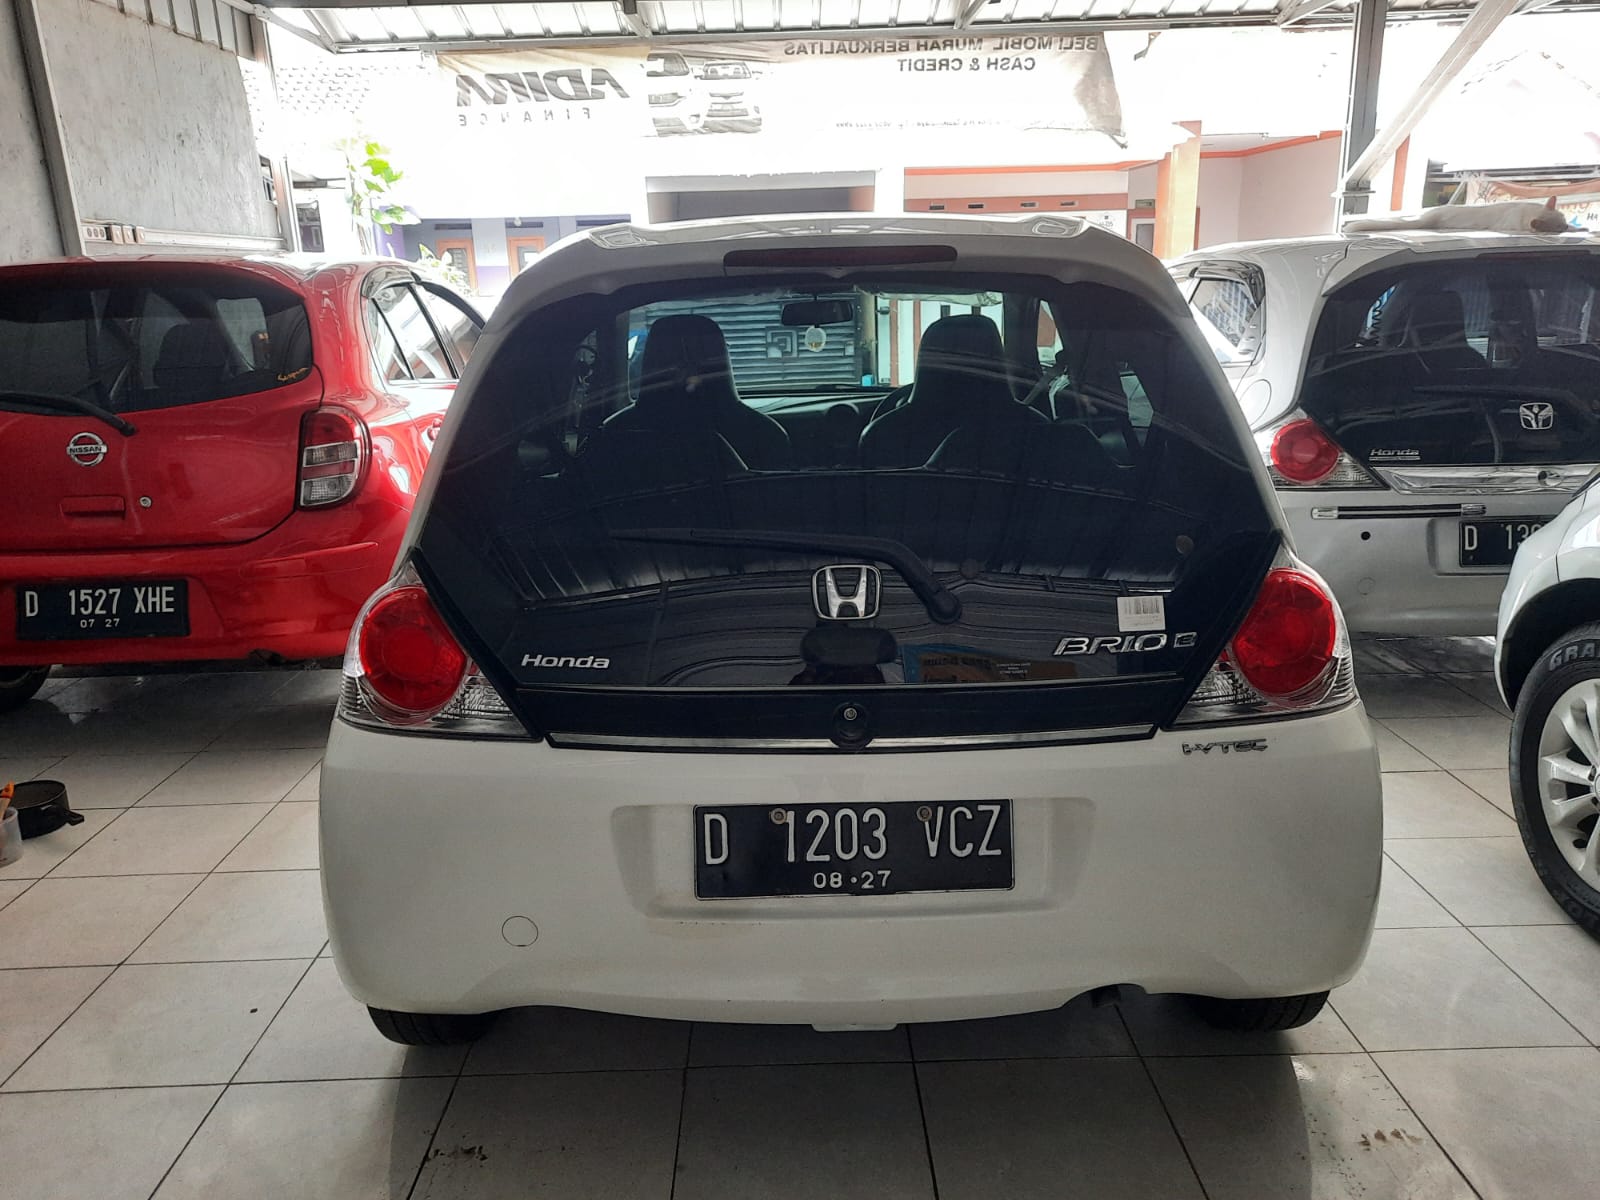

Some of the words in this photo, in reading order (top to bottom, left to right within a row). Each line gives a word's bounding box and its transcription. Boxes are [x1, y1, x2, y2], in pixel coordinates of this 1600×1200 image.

[1370, 448, 1420, 456] Honda
[1465, 525, 1478, 551] D
[25, 591, 39, 617] D
[69, 588, 121, 616] 1527
[134, 586, 175, 613] XHE
[80, 619, 95, 628] 07
[105, 618, 120, 627] 27
[1053, 633, 1167, 655] BRIO
[521, 654, 610, 669] Honda
[1549, 642, 1600, 671] GRA
[704, 813, 729, 865] D
[785, 808, 887, 863] 1203
[920, 804, 1002, 857] VCZ
